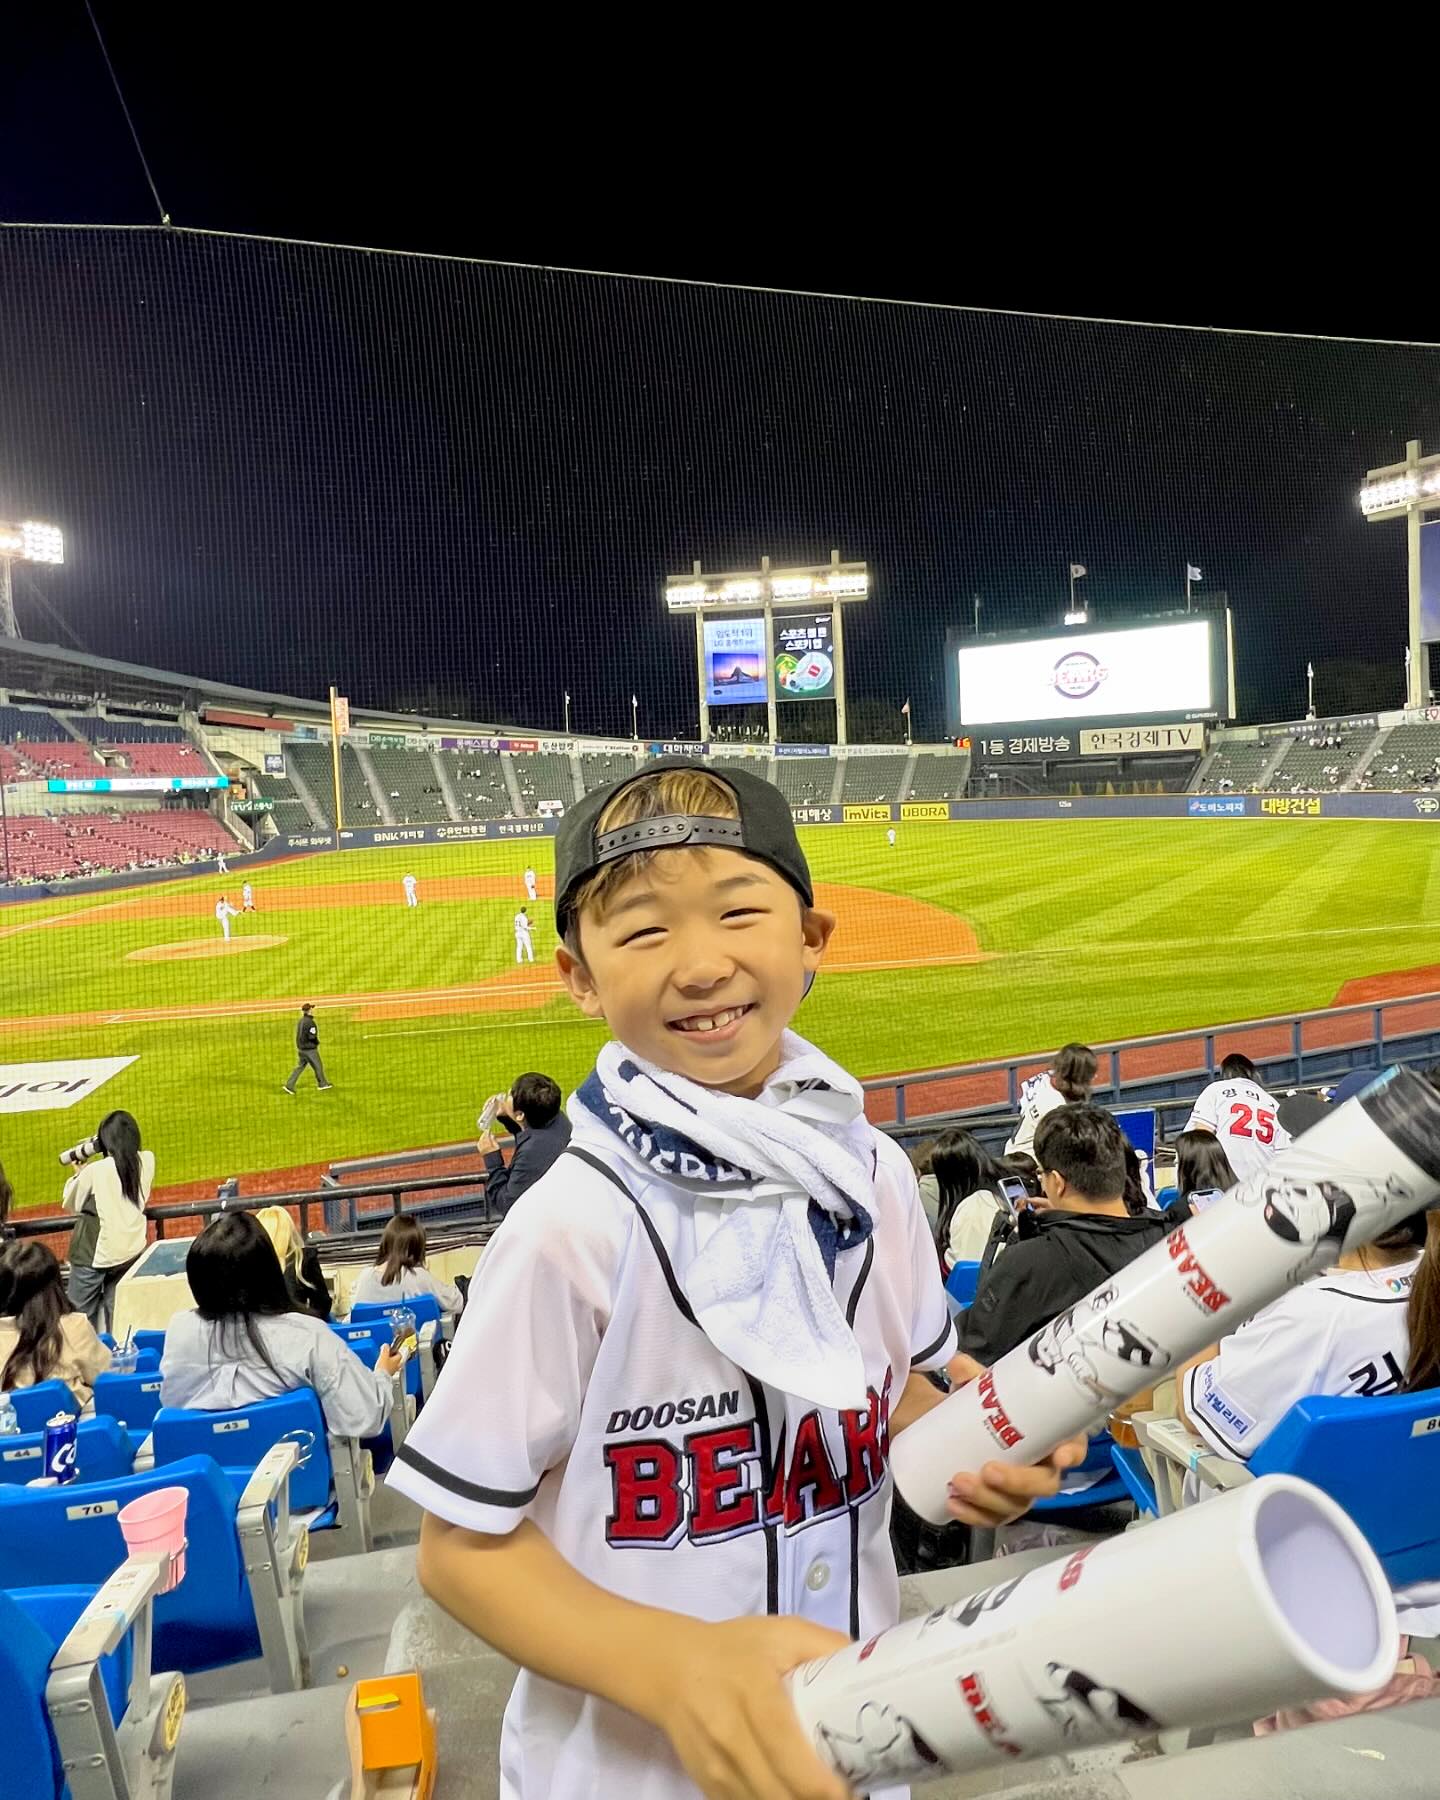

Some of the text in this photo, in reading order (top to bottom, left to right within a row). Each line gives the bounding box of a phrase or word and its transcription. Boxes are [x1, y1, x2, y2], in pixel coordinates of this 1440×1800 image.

[979, 736, 1071, 756] 1등 경제방송
[1090, 728, 1192, 751] 한국경제TV
[902, 806, 947, 818] UBORA
[1261, 797, 1321, 815] 대방건설
[1229, 1102, 1275, 1145] 25
[605, 1390, 739, 1434] DOOSAN
[82, 1505, 104, 1516] 70
